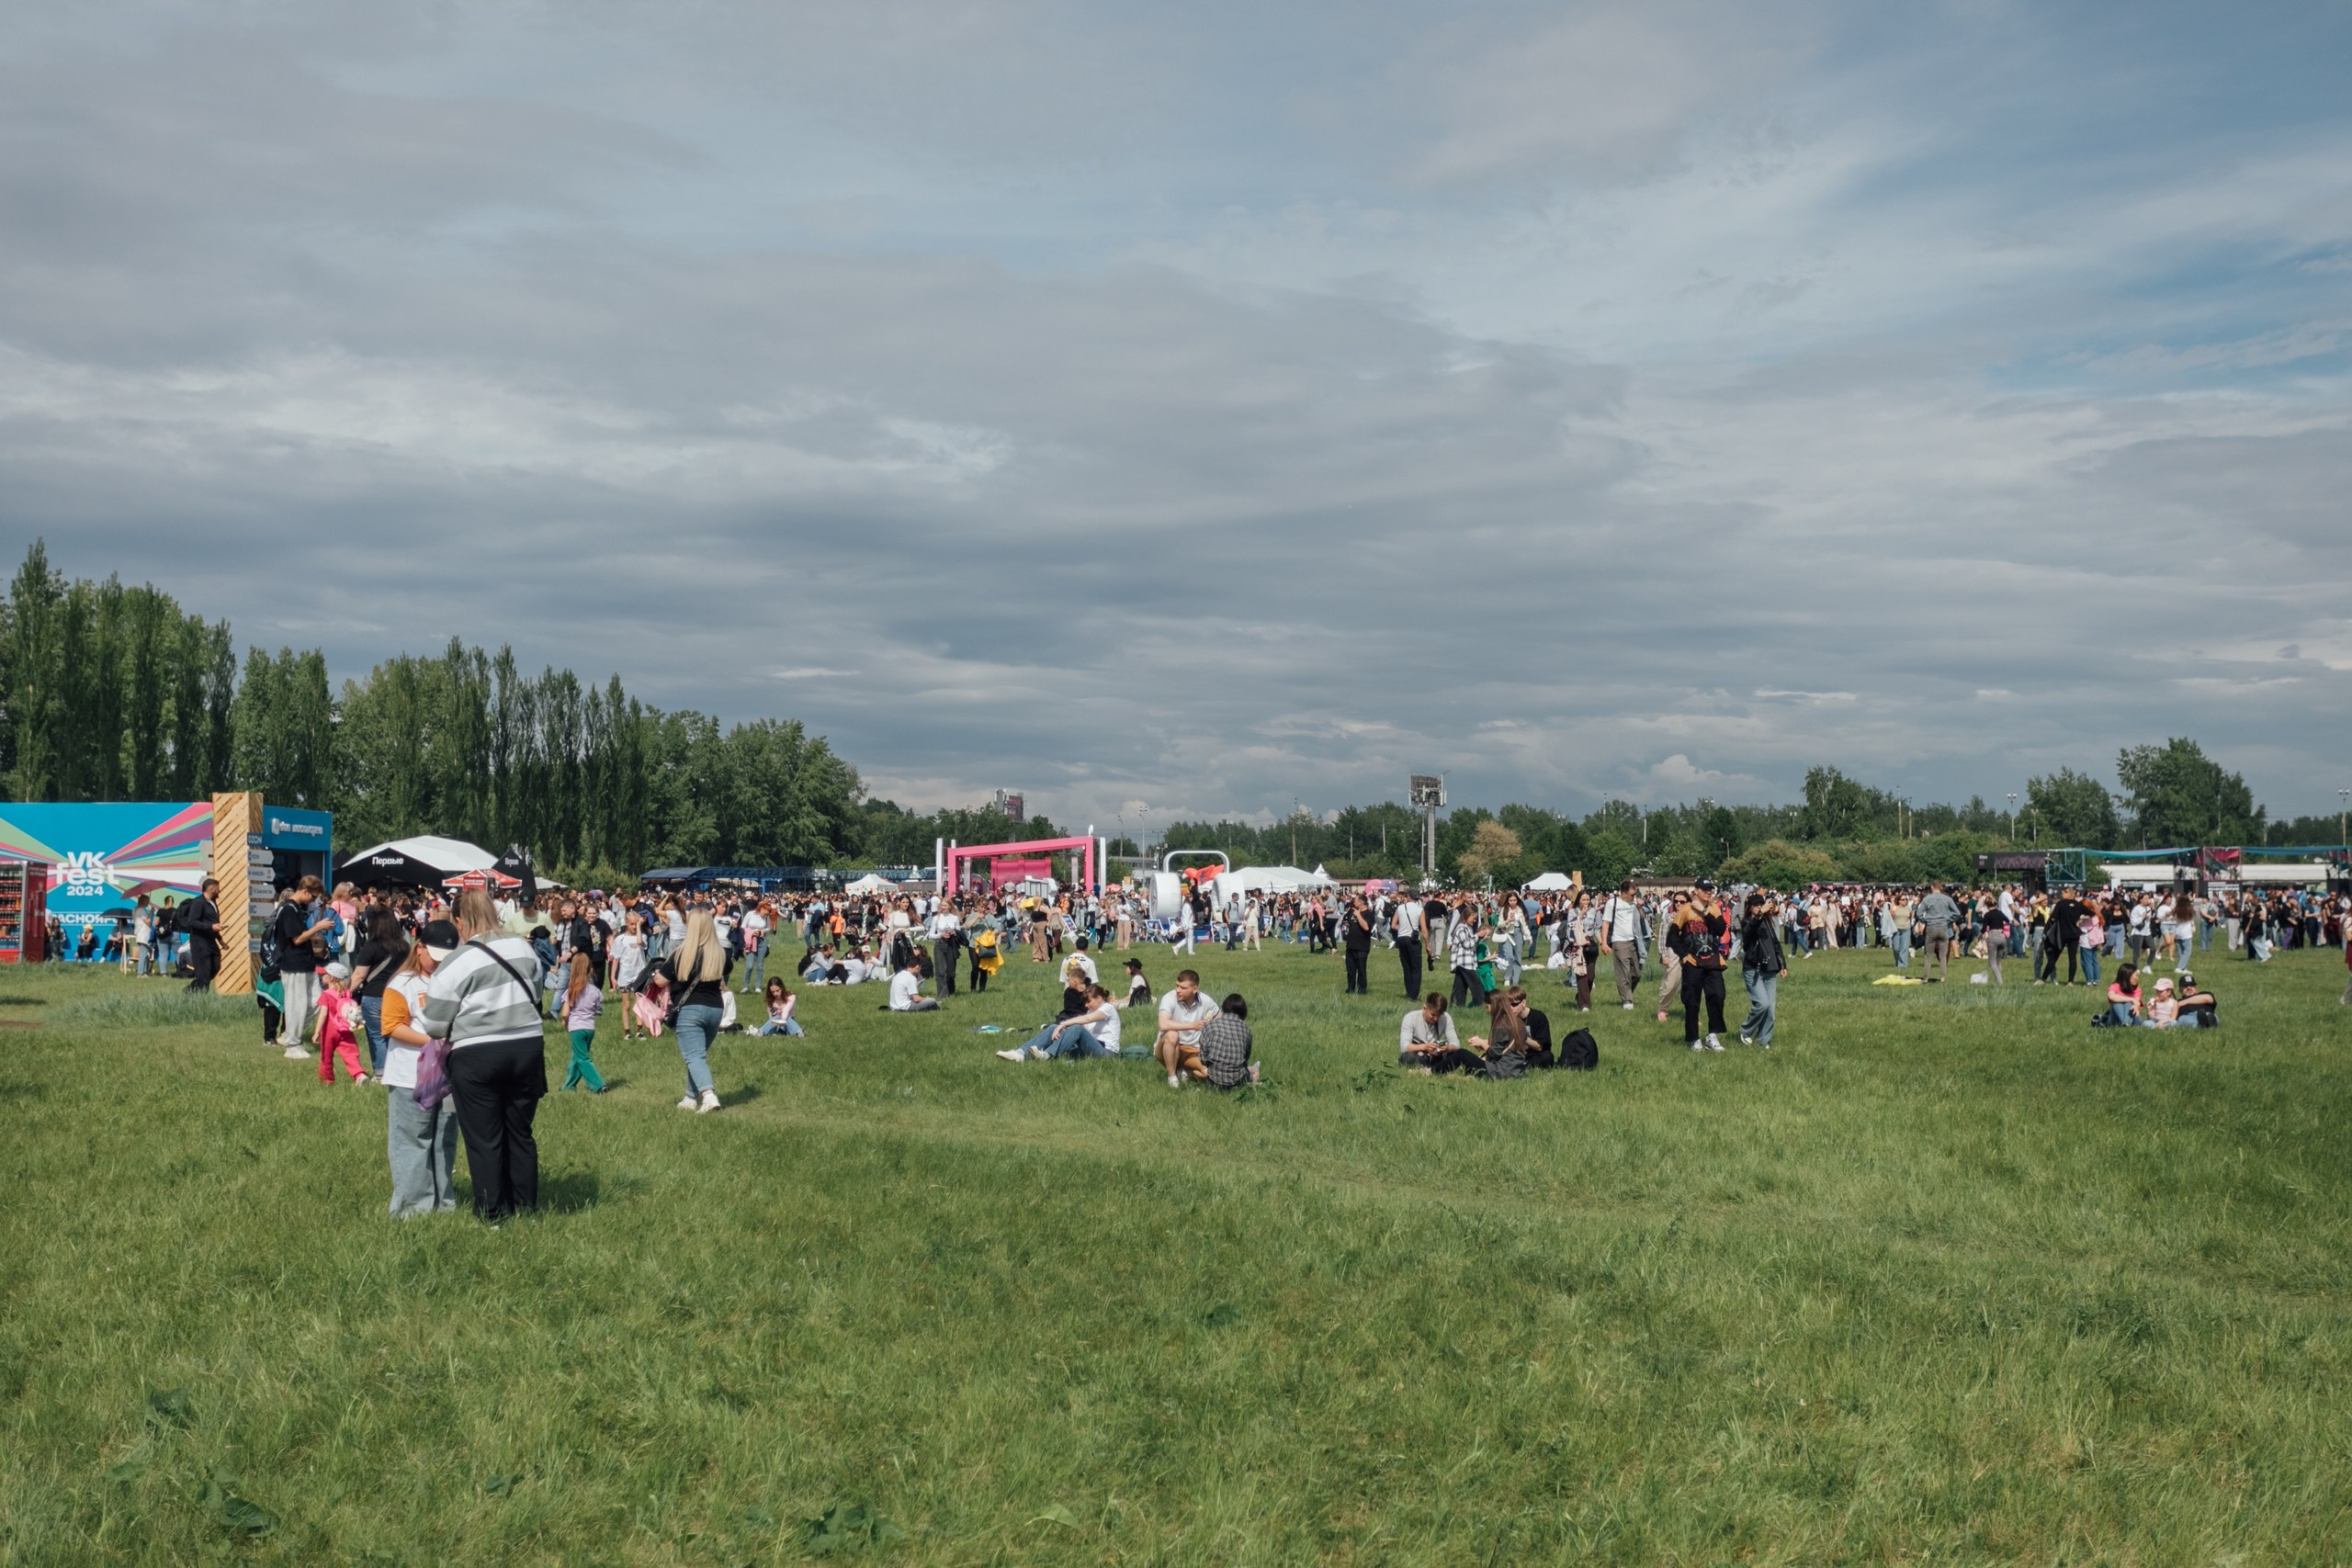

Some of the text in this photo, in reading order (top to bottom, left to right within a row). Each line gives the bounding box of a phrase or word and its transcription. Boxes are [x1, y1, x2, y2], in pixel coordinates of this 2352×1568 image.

[66, 852, 106, 868] VK
[372, 856, 404, 867] Первые
[55, 862, 119, 886] fest
[66, 886, 104, 897] 2024
